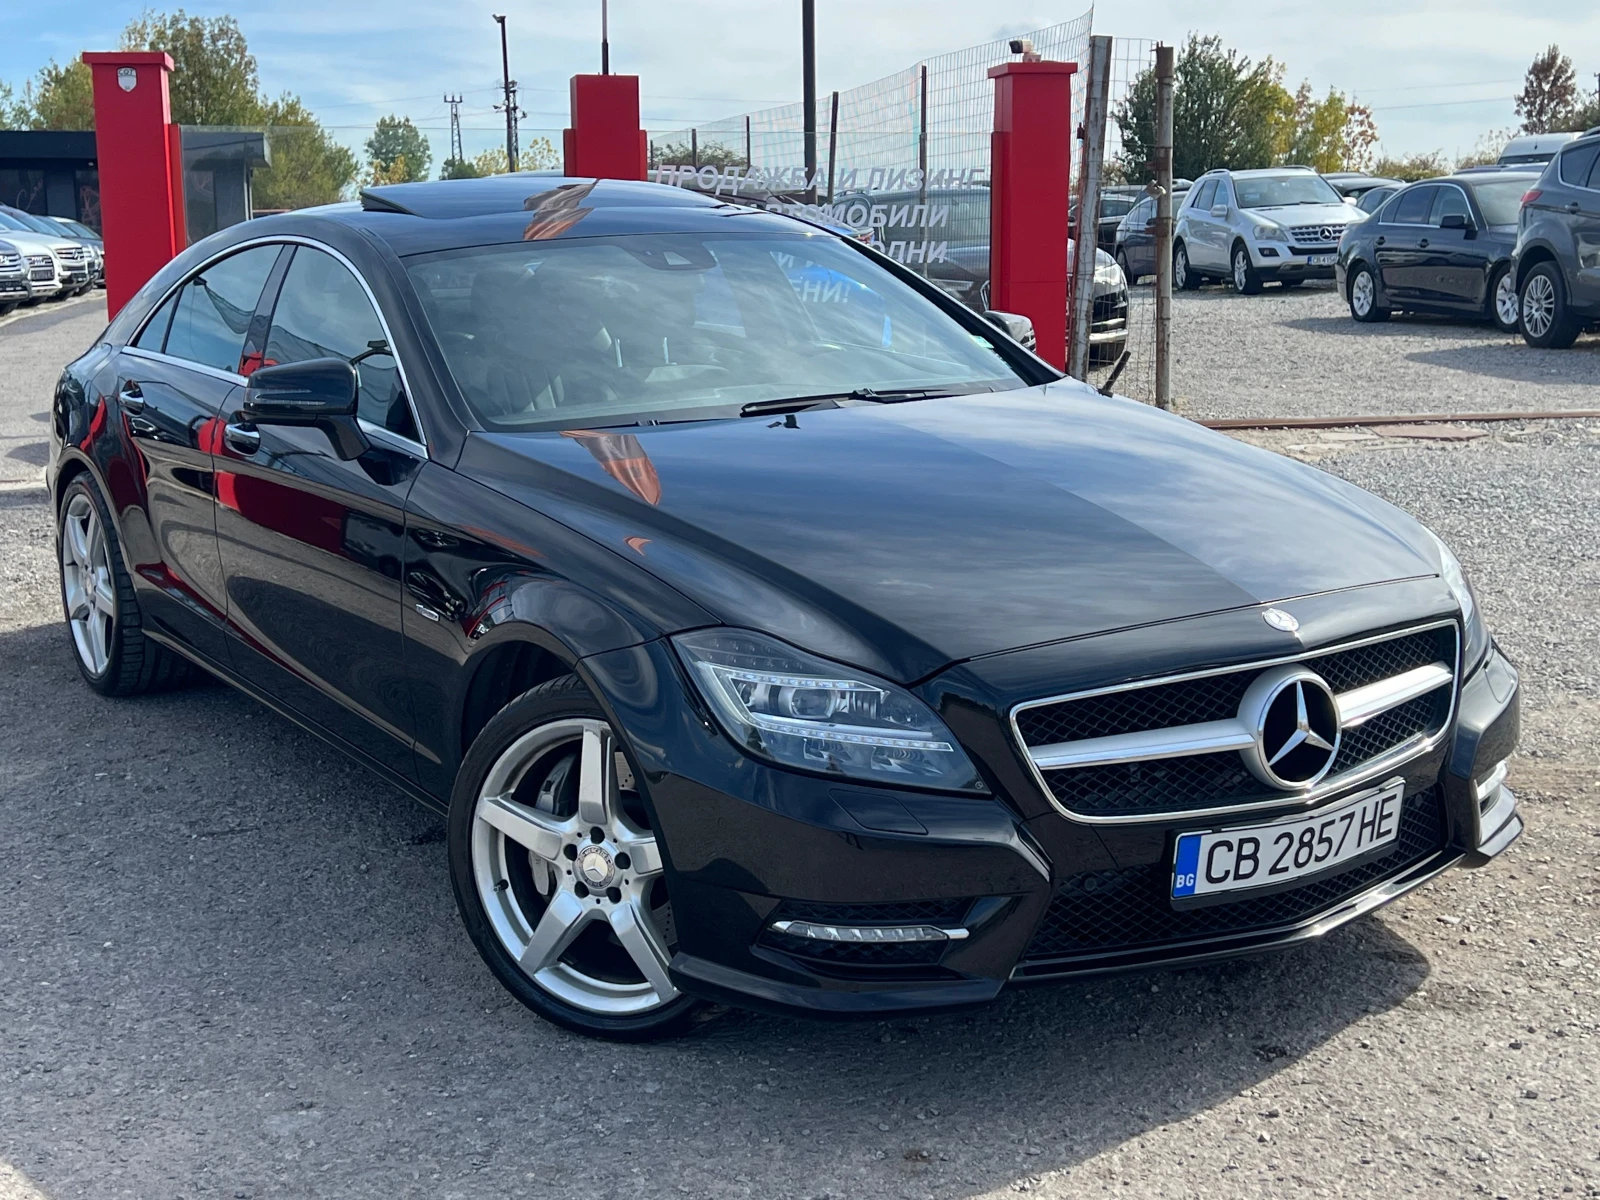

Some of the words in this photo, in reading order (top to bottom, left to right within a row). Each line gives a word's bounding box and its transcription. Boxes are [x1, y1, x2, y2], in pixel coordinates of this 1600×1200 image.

[655, 165, 827, 196] ПРОДАЖБА
[837, 168, 860, 190] И
[864, 167, 985, 192] ЛИЗИНГ
[752, 203, 949, 229] ТОМОБИЛИ
[1204, 837, 1260, 884] CB
[1268, 811, 1356, 876] 2857
[1356, 793, 1398, 848] HE
[1175, 873, 1195, 889] BG
